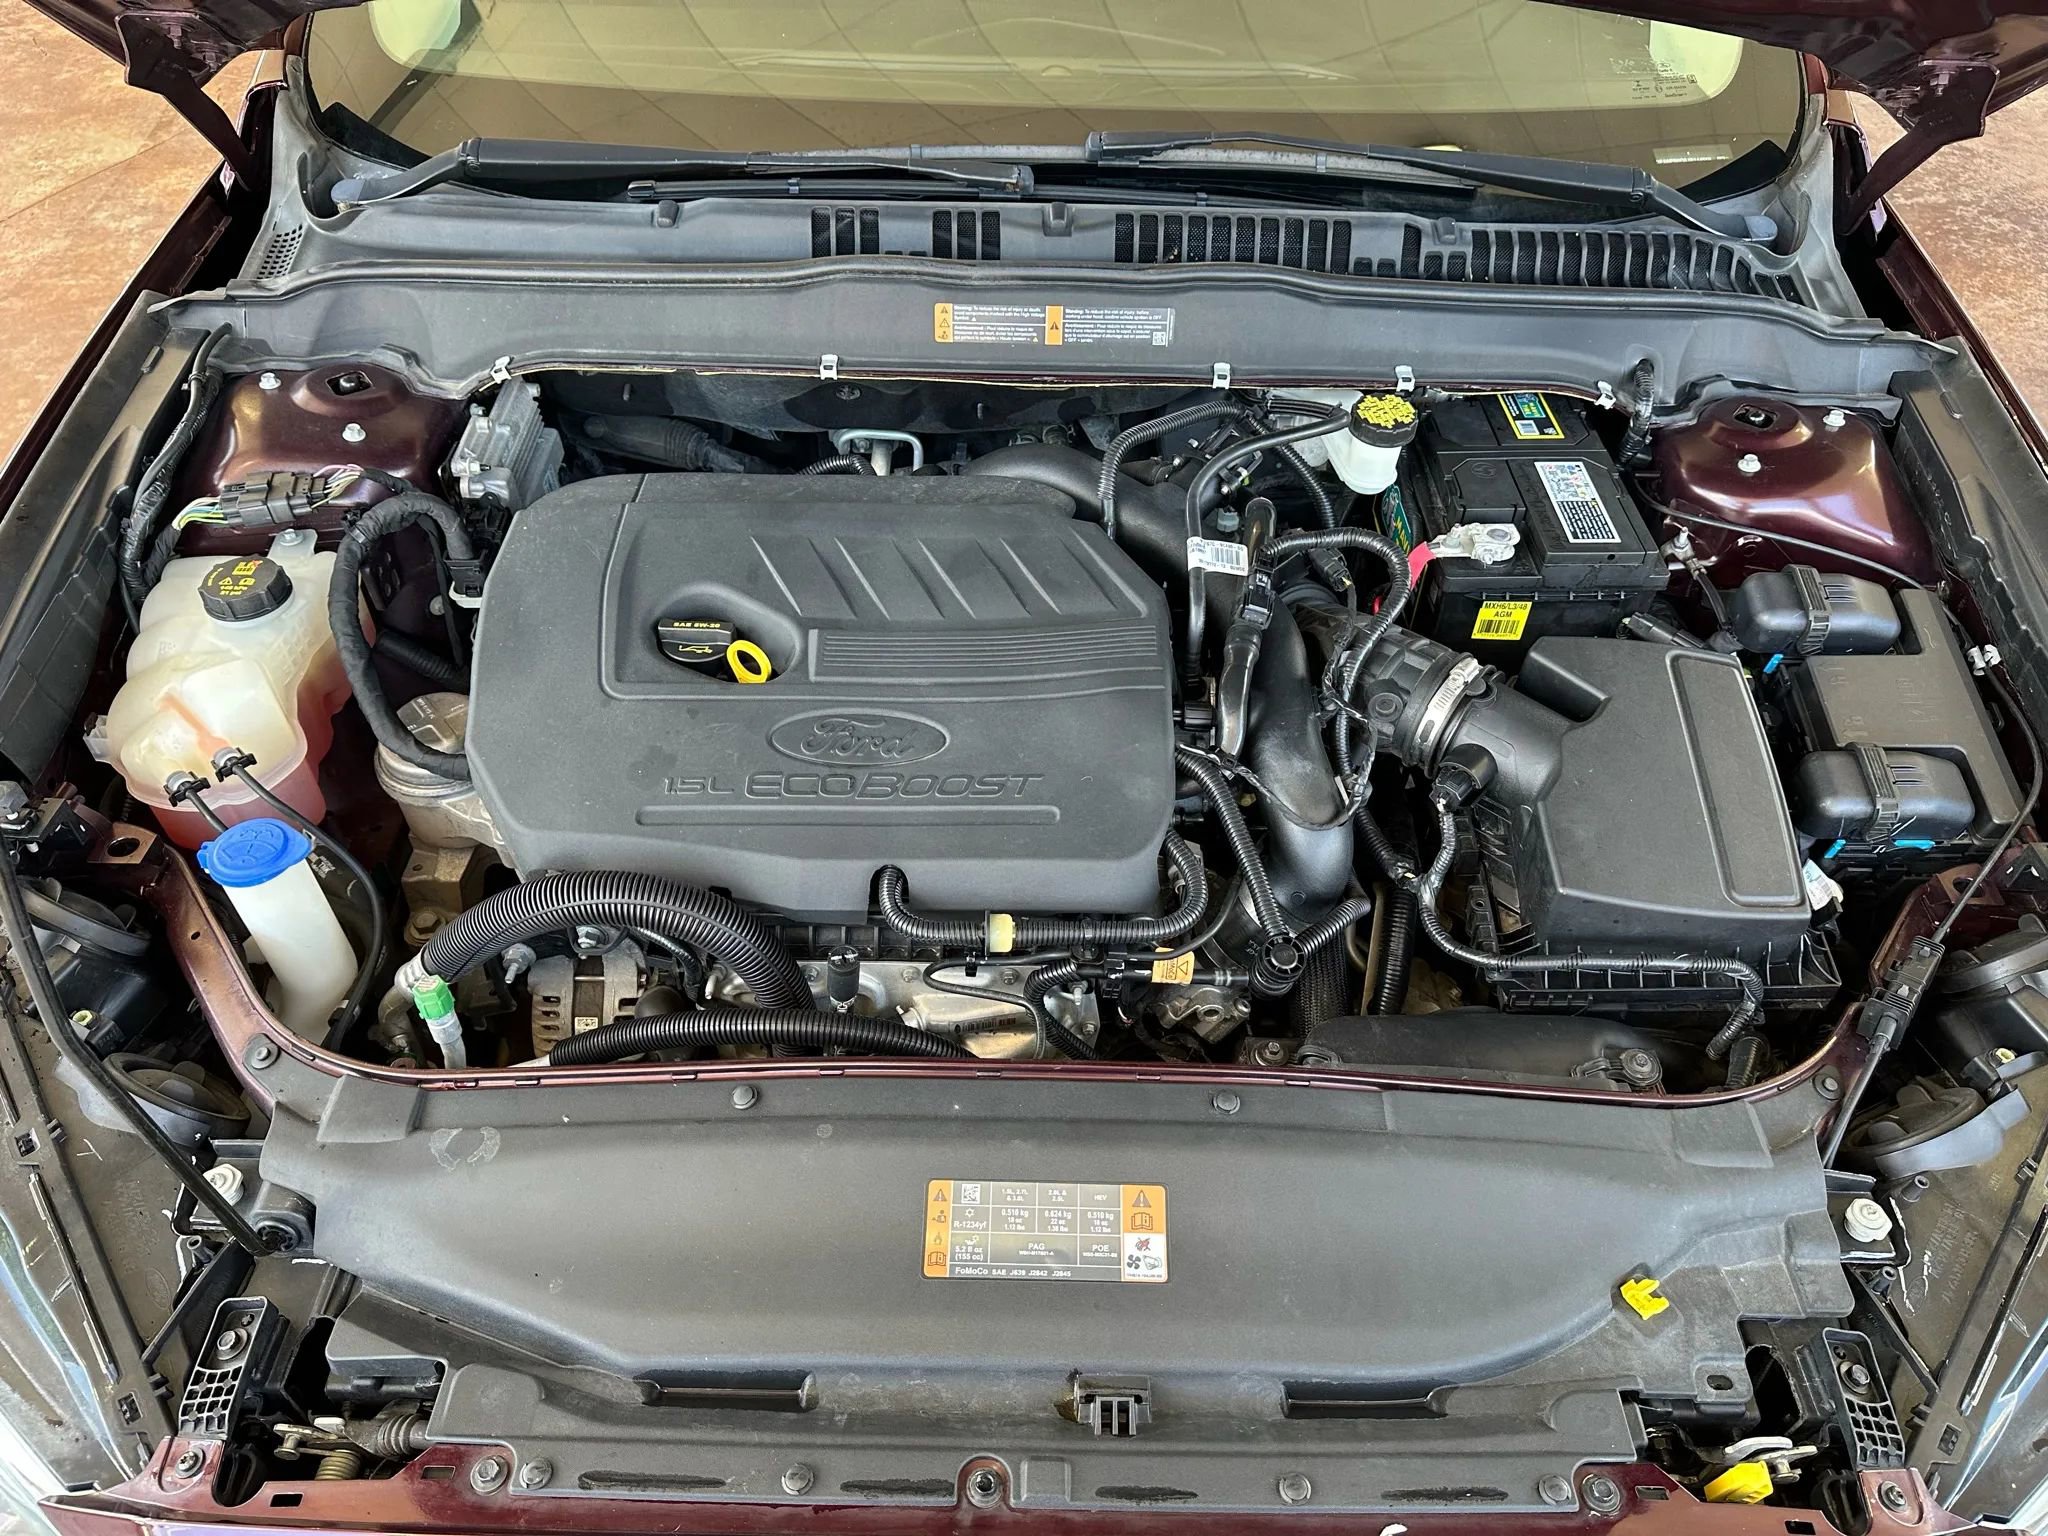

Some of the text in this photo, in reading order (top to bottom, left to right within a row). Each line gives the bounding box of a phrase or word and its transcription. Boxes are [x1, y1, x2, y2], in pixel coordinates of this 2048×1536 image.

[801, 719, 918, 757] Ford
[1019, 1209, 1029, 1218] kg
[1063, 1210, 1072, 1220] kg
[1106, 1212, 1114, 1221] kg
[953, 1220, 987, 1230] R-1234yf
[1028, 1243, 1045, 1251] PAG
[1092, 1244, 1110, 1252] POE
[971, 1253, 984, 1262] cc)
[955, 1267, 989, 1275] FoMoCo
